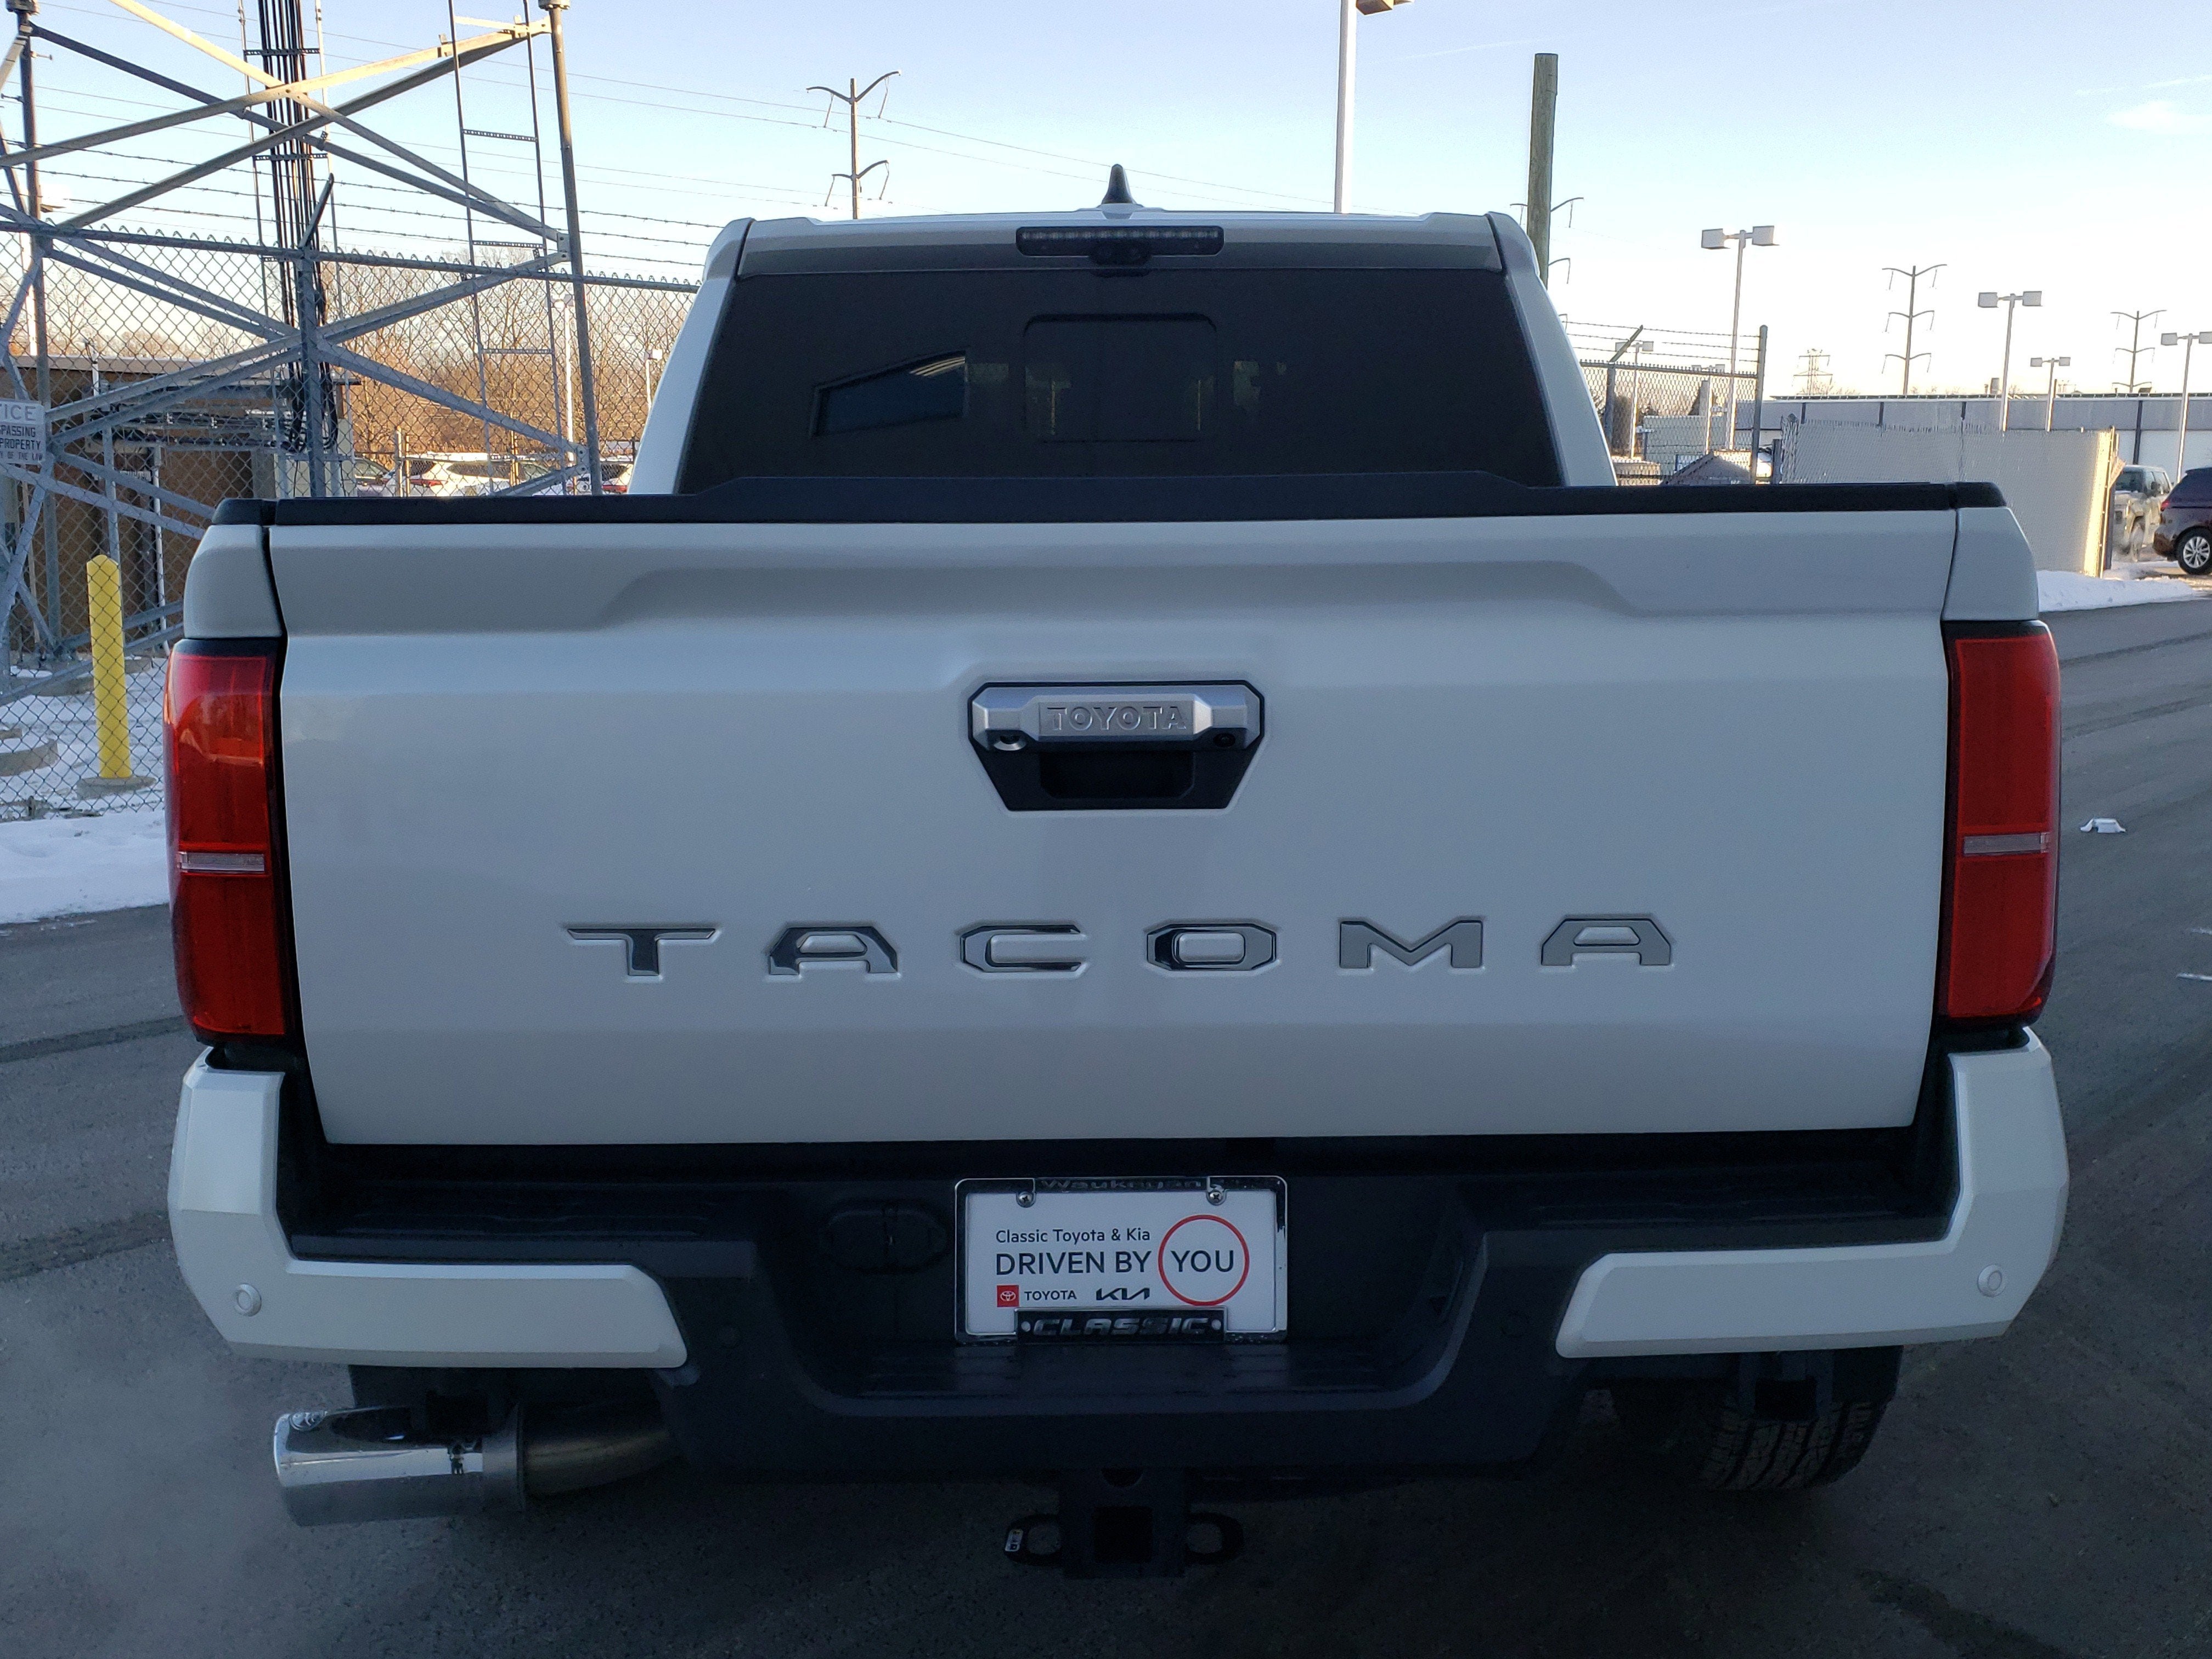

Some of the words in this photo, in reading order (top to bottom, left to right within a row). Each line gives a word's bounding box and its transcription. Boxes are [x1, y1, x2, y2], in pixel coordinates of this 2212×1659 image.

[0, 404, 36, 421] ICE
[0, 425, 36, 437] PASSING
[19, 452, 28, 460] THE
[32, 453, 43, 461] LAW
[1046, 706, 1187, 731] TOYOTA
[566, 918, 1672, 977] TACOMA
[996, 1229, 1048, 1243] Classic
[1052, 1229, 1105, 1245] Toyota
[1111, 1229, 1121, 1240] &
[1126, 1227, 1150, 1241] Kia
[996, 1251, 1105, 1276] DRIVEN
[1115, 1250, 1152, 1273] BY
[1170, 1250, 1234, 1273] YOU
[1024, 1290, 1077, 1301] TOYOTA
[1032, 1317, 1209, 1336] CLASSIC
